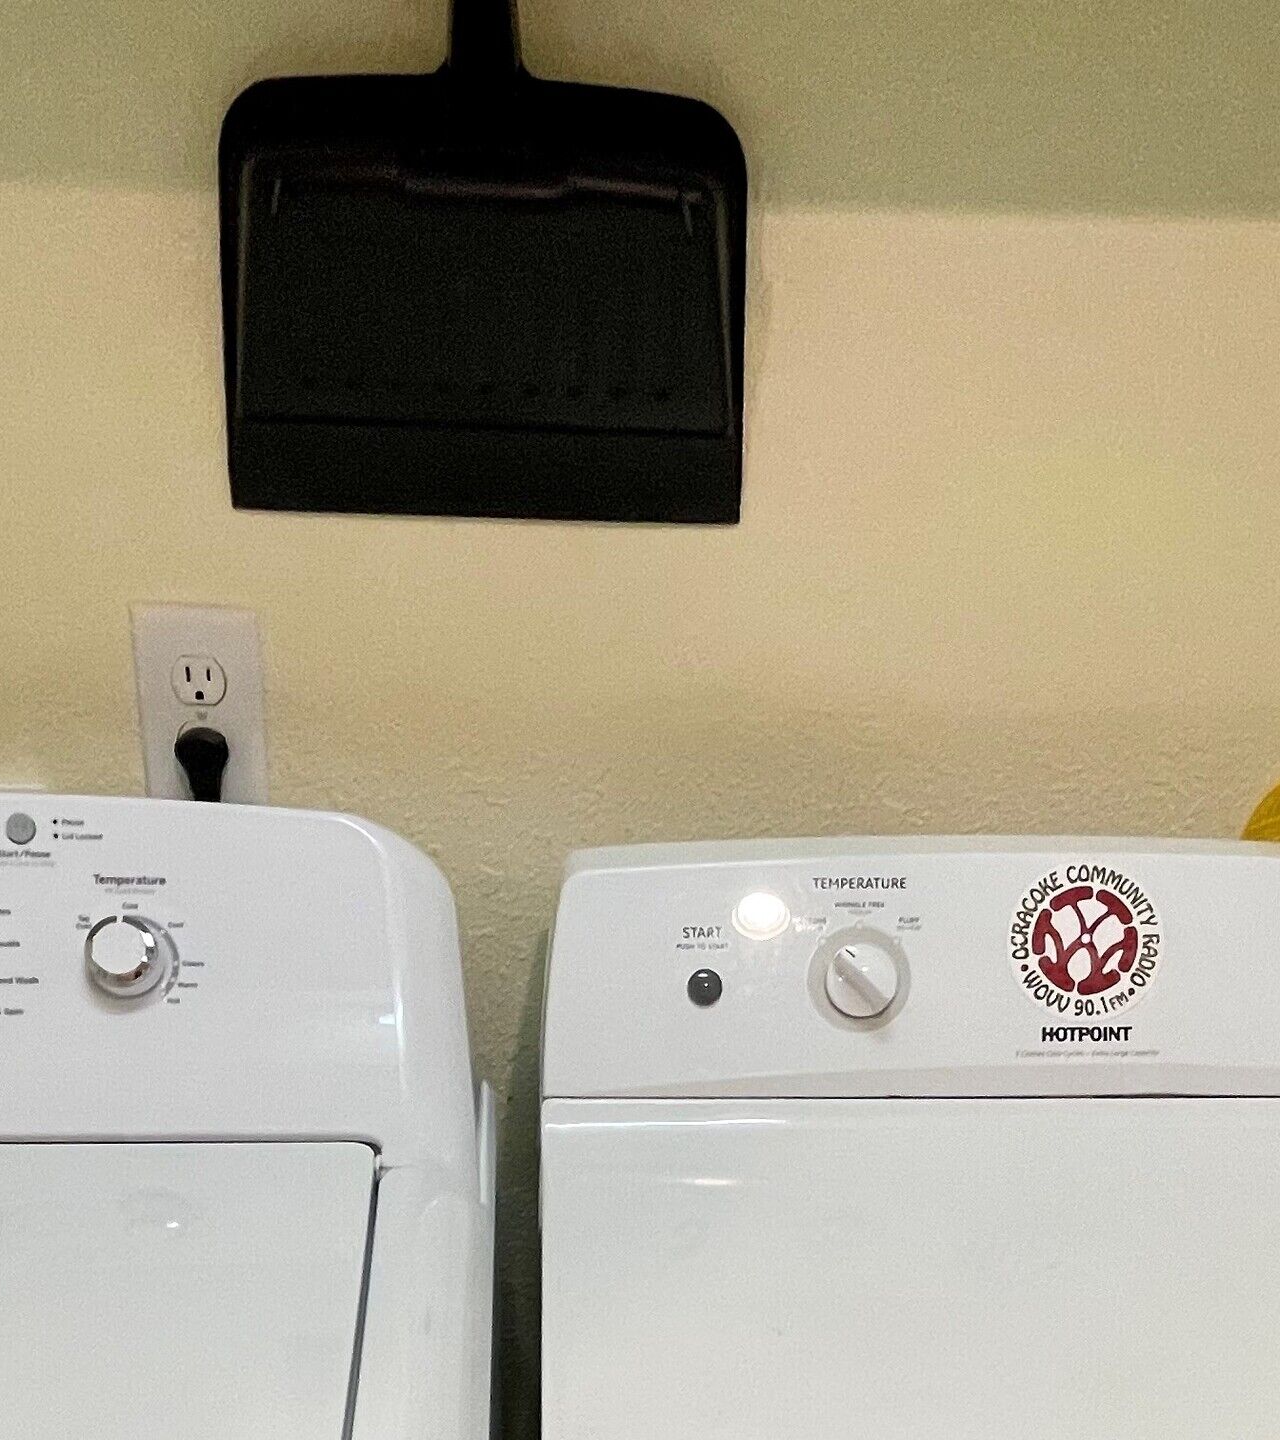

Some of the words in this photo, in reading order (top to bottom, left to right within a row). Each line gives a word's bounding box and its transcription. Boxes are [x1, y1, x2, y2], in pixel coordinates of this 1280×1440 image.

[94, 873, 167, 886] Temperature
[812, 876, 907, 890] TEMPERATURE
[682, 926, 723, 940] START
[1011, 871, 1064, 960] OCRACOKE
[1066, 864, 1159, 927] COMMUNITY
[1129, 933, 1161, 988] RADIO
[1075, 996, 1109, 1016] 90.1
[1109, 991, 1130, 1011] FM
[1041, 1026, 1133, 1042] HOTPOINT
